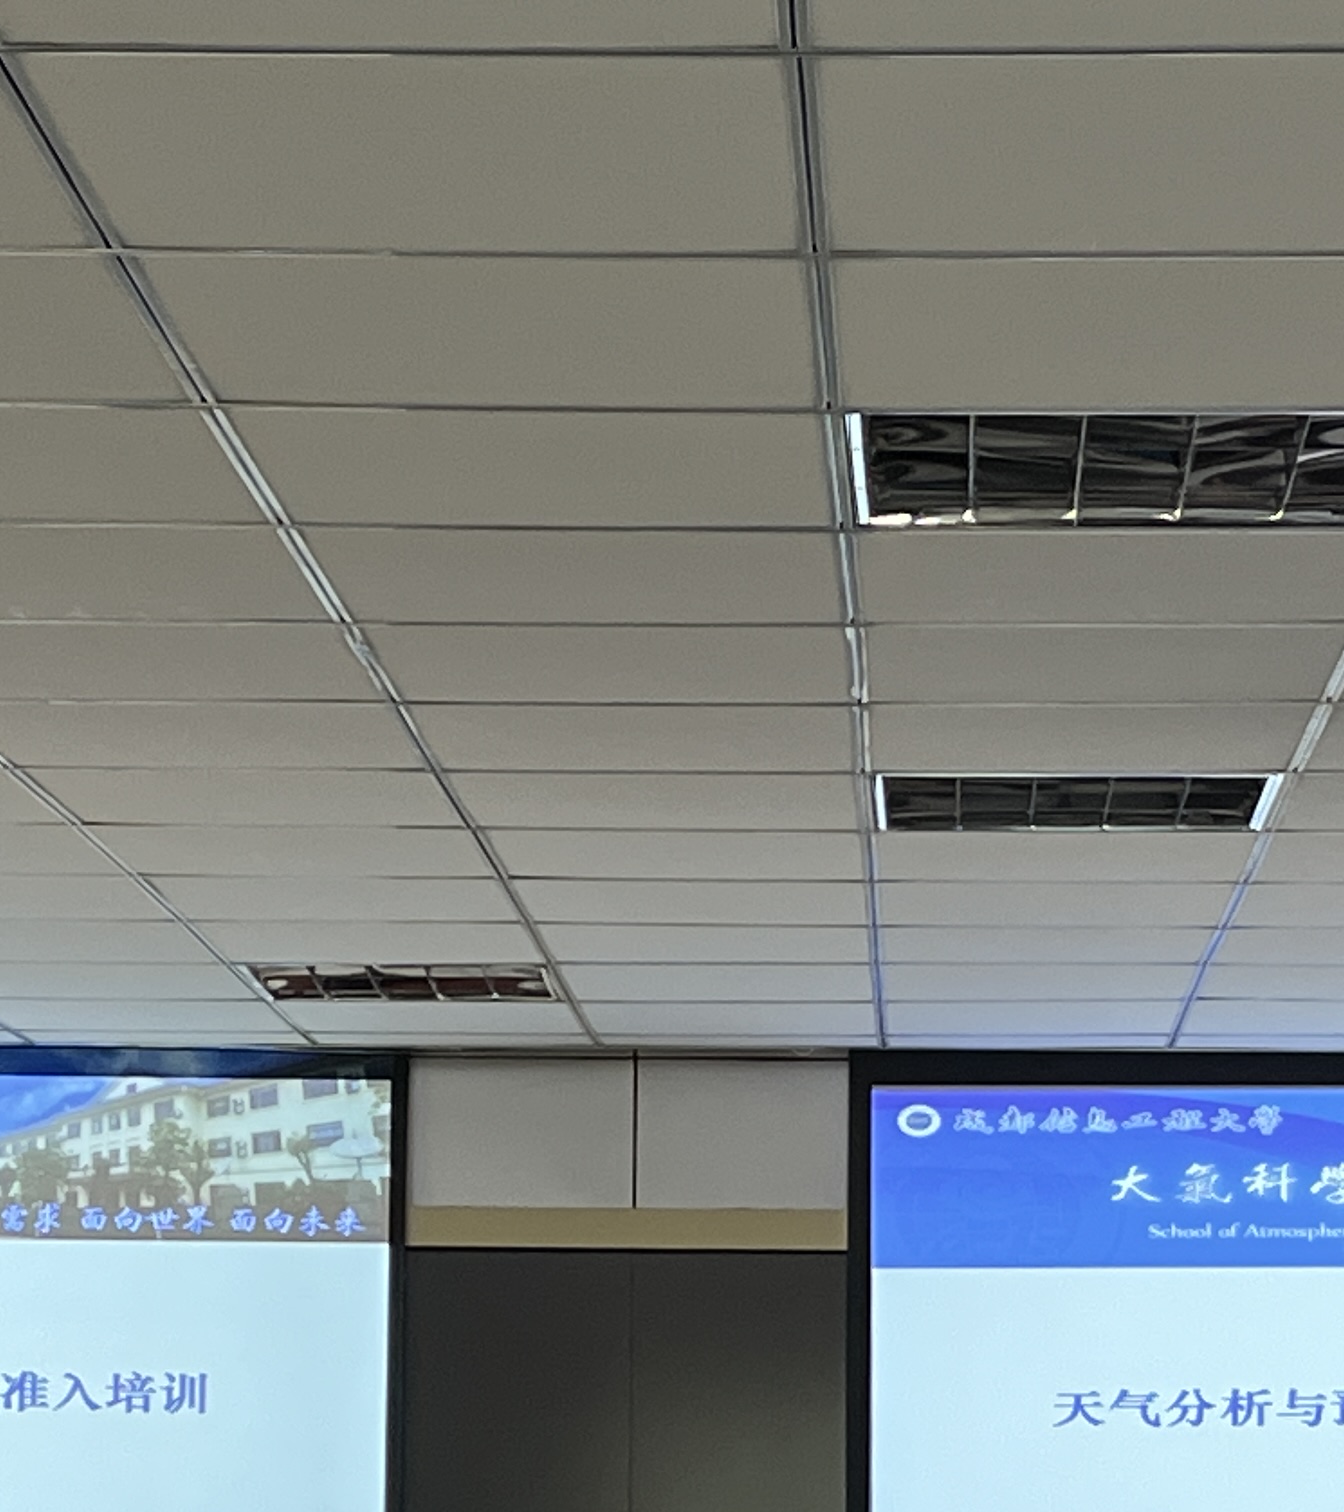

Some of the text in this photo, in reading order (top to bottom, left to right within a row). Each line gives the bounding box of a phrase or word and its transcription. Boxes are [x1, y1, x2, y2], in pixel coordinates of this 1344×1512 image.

[80, 1205, 214, 1235] 面向世界
[229, 1205, 367, 1238] 面向未来
[1147, 1222, 1212, 1239] School
[1217, 1221, 1240, 1239] of
